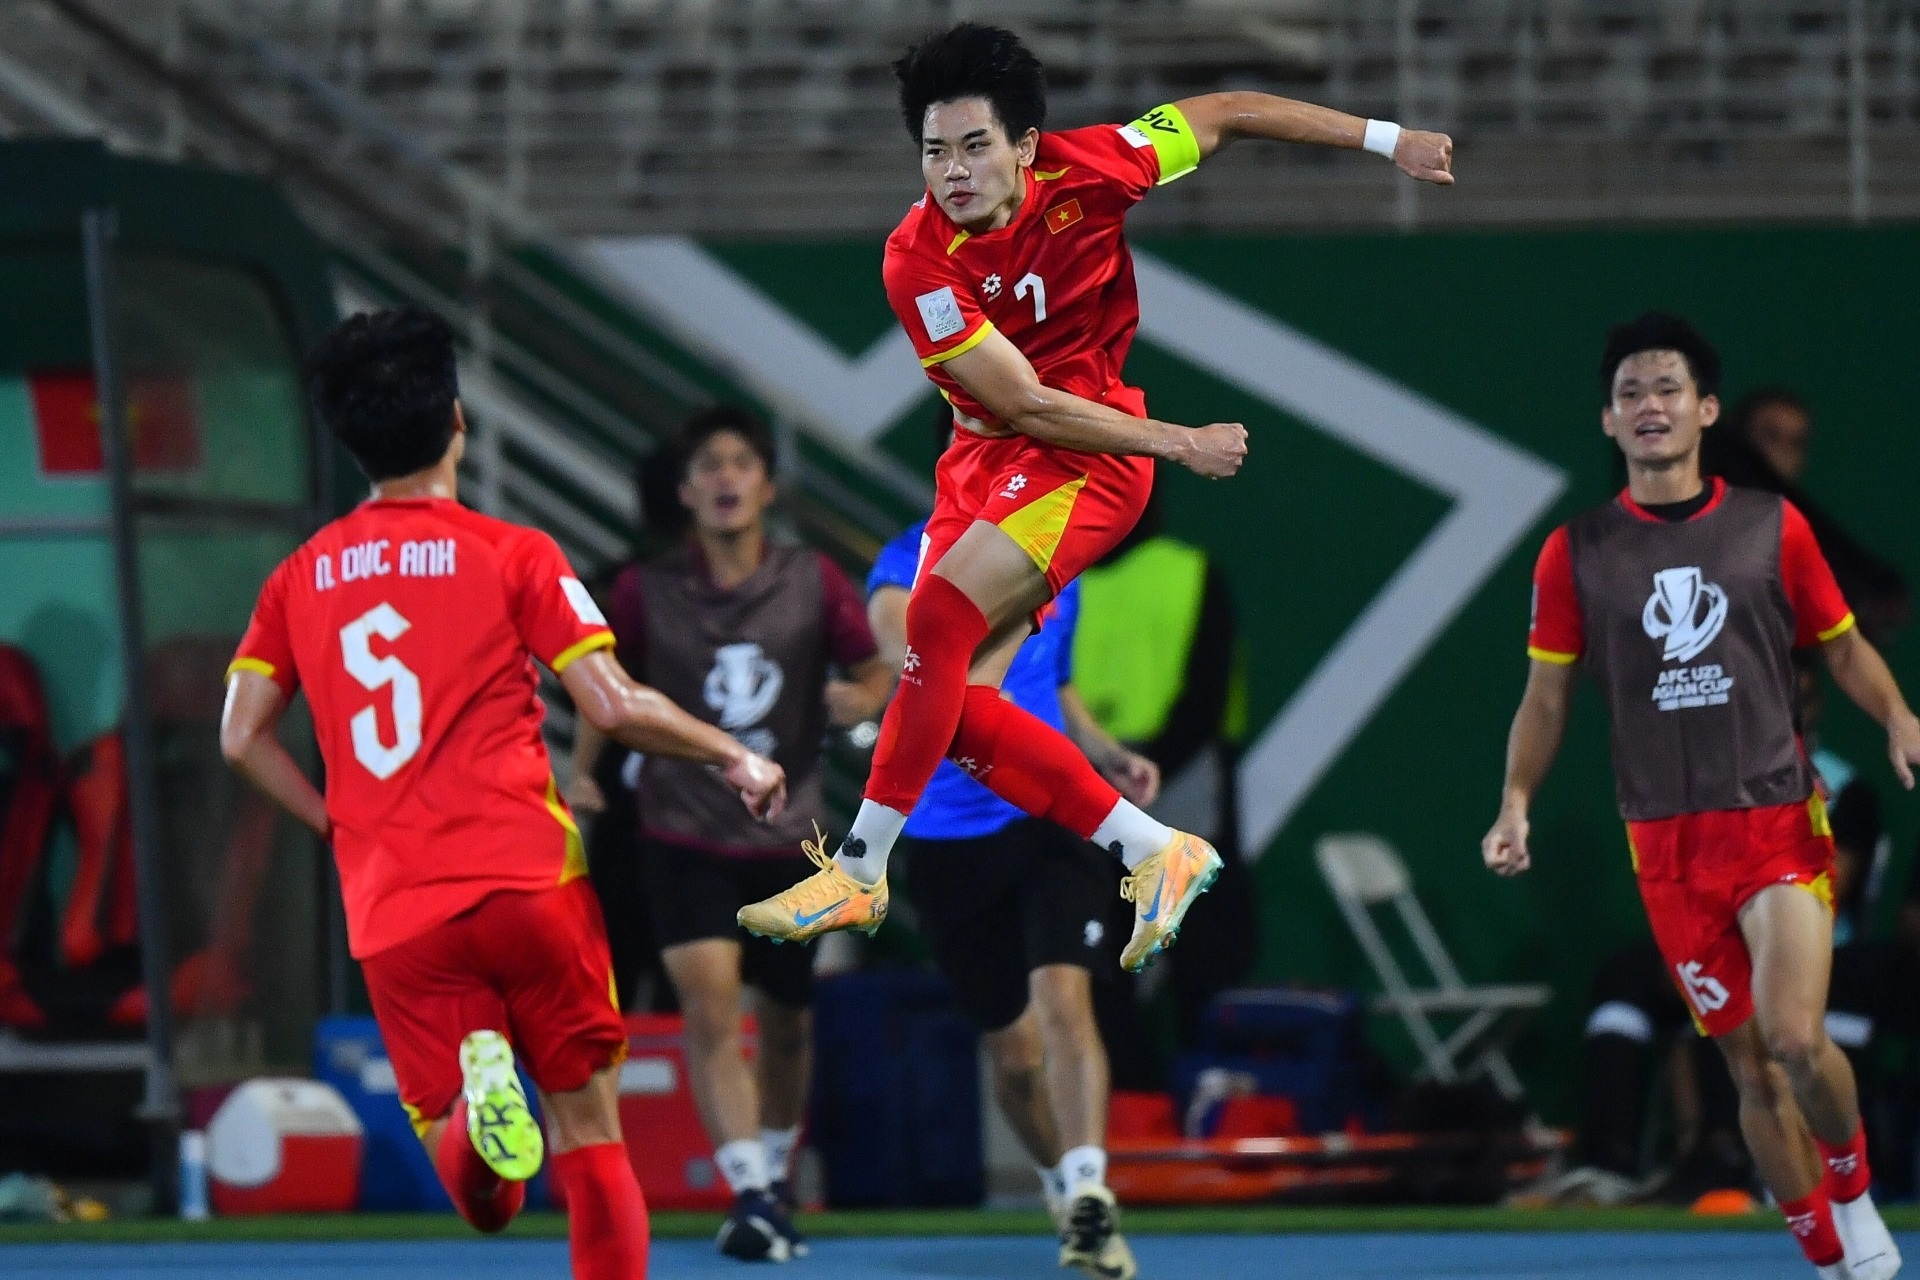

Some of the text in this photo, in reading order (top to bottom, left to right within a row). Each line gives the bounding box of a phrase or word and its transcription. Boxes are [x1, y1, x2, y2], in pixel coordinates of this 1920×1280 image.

[1013, 272, 1047, 324] 7
[399, 537, 456, 577] ANH
[339, 601, 422, 781] 5
[1657, 669, 1691, 686] AFC
[1699, 677, 1734, 695] CUP
